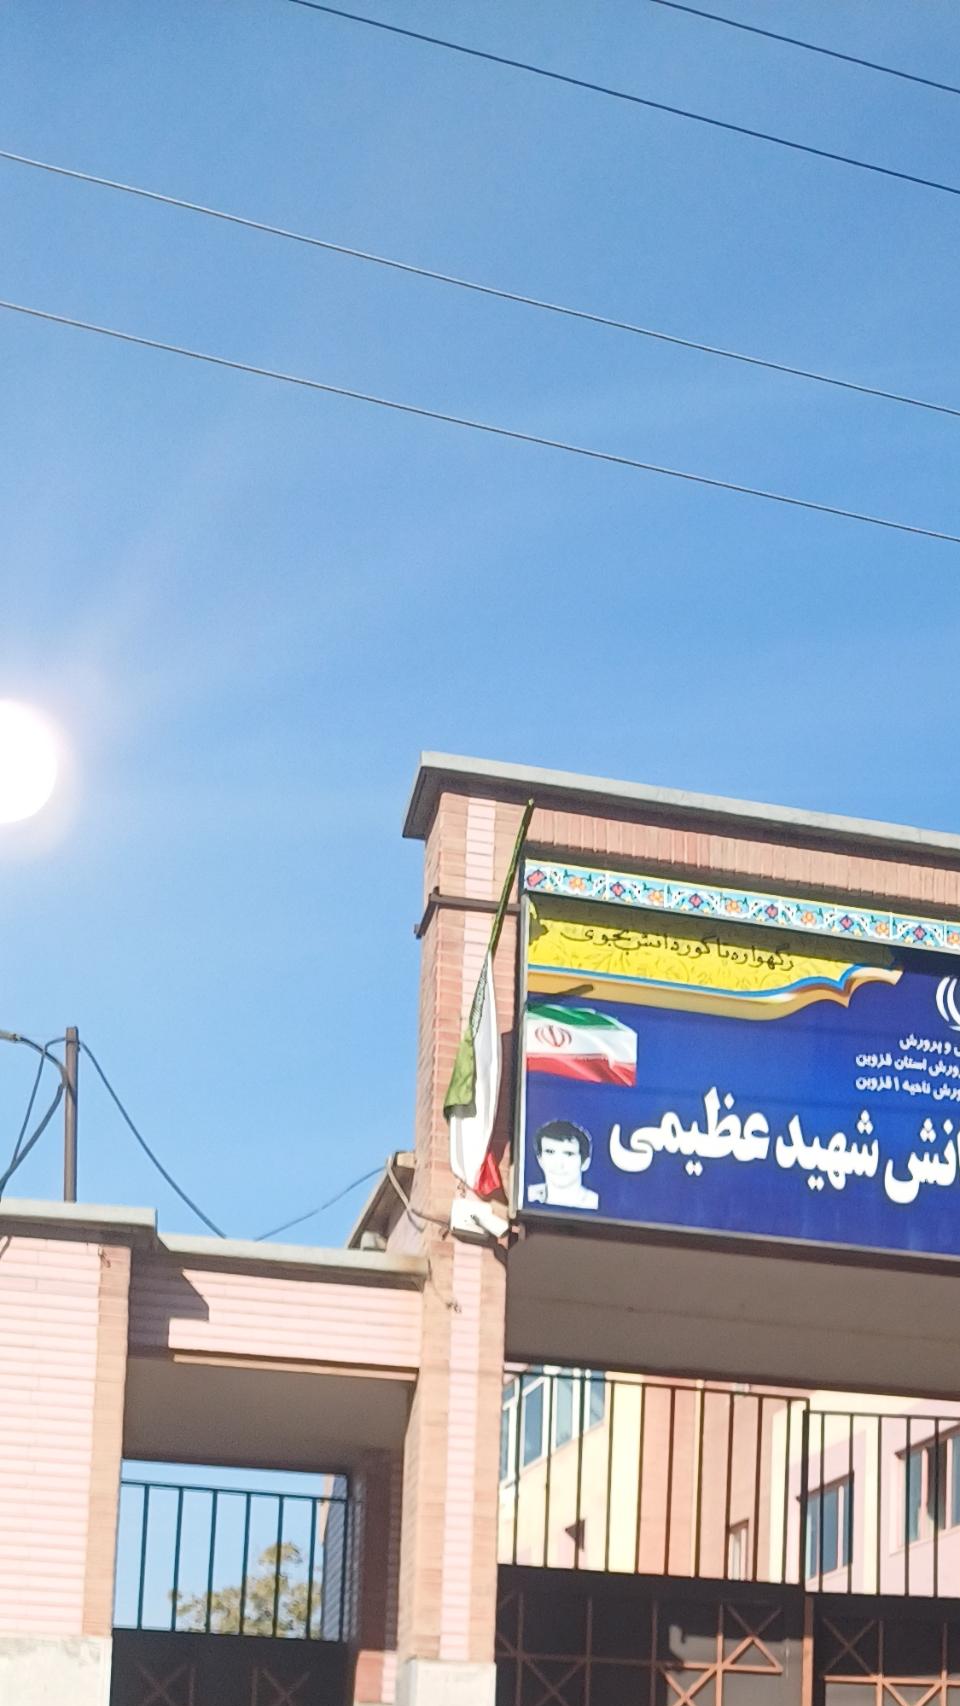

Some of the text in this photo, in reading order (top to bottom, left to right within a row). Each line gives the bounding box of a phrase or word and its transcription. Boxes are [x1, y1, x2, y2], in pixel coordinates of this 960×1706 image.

[899, 1033, 943, 1055] پرورش
[944, 1041, 952, 1055] و
[855, 1053, 893, 1070] قزوین
[894, 1055, 928, 1071] استان
[855, 1075, 893, 1092] قزوین
[902, 1080, 931, 1096] ناحیه
[608, 1086, 771, 1177] عظیمی
[775, 1109, 880, 1191] شهید
